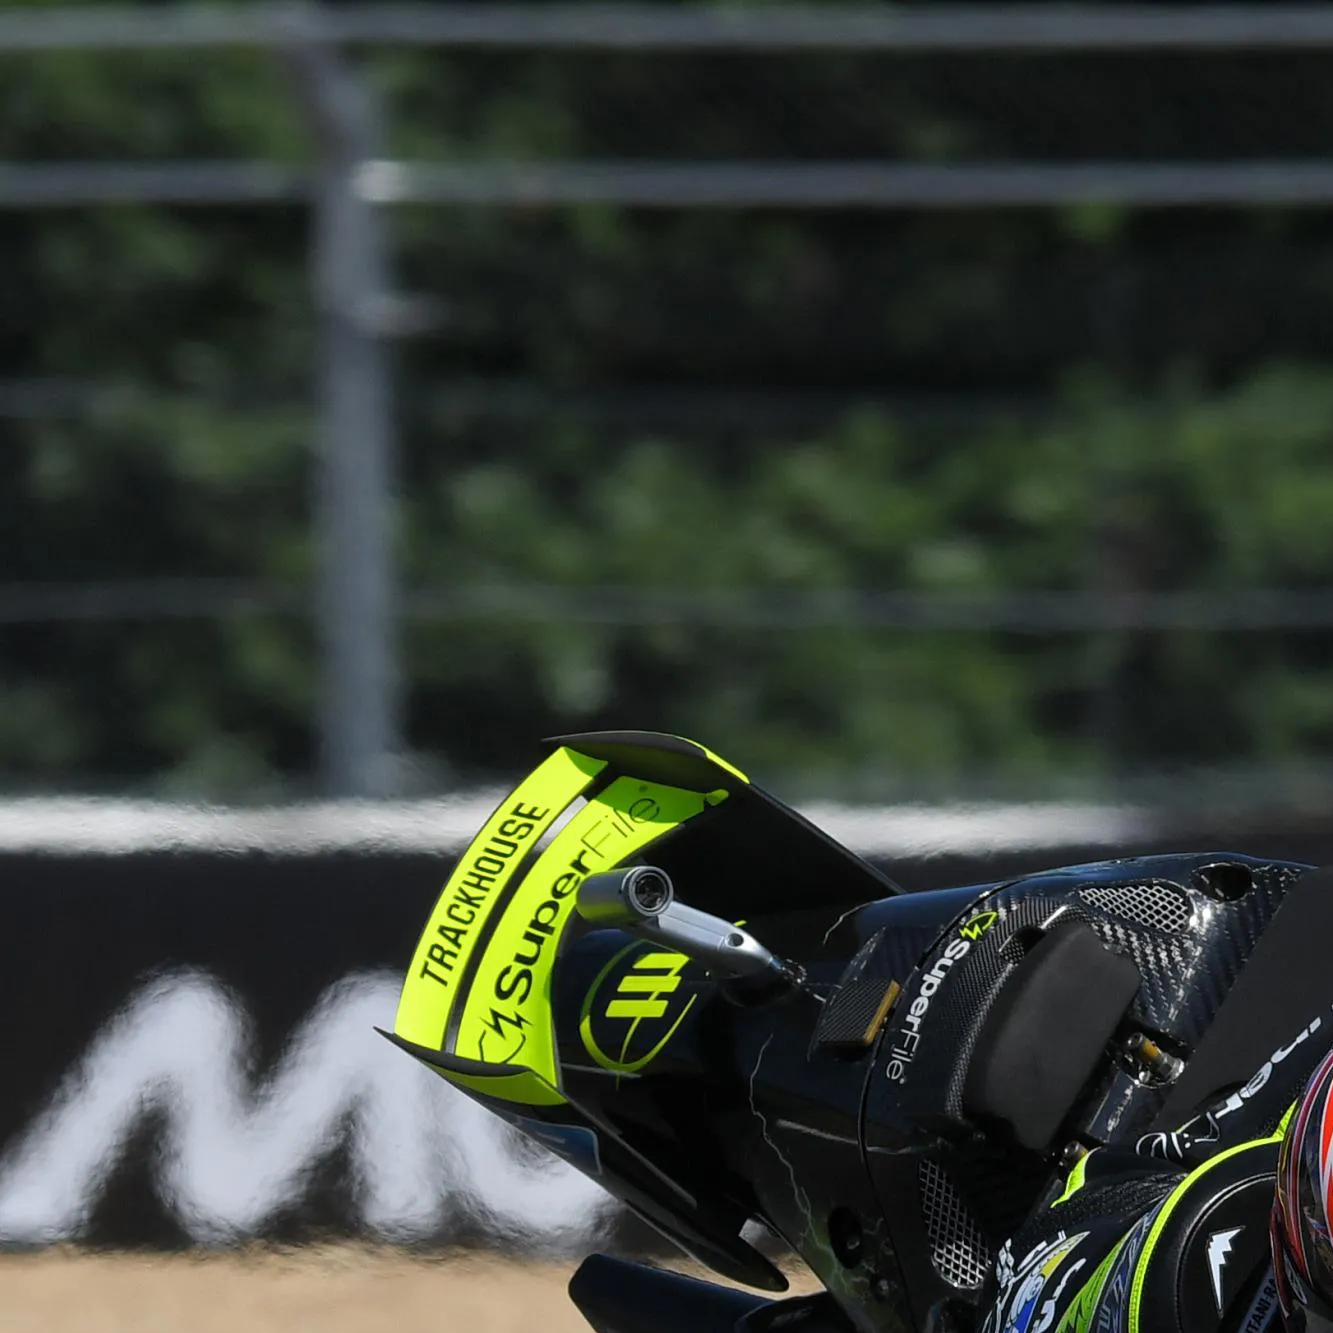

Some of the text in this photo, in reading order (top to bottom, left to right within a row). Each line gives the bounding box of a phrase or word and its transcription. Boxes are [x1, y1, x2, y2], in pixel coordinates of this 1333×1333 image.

[420, 801, 549, 989] TRACKHOUSE
[495, 797, 660, 1003] SuperFile
[886, 938, 970, 1081] SuperFile
